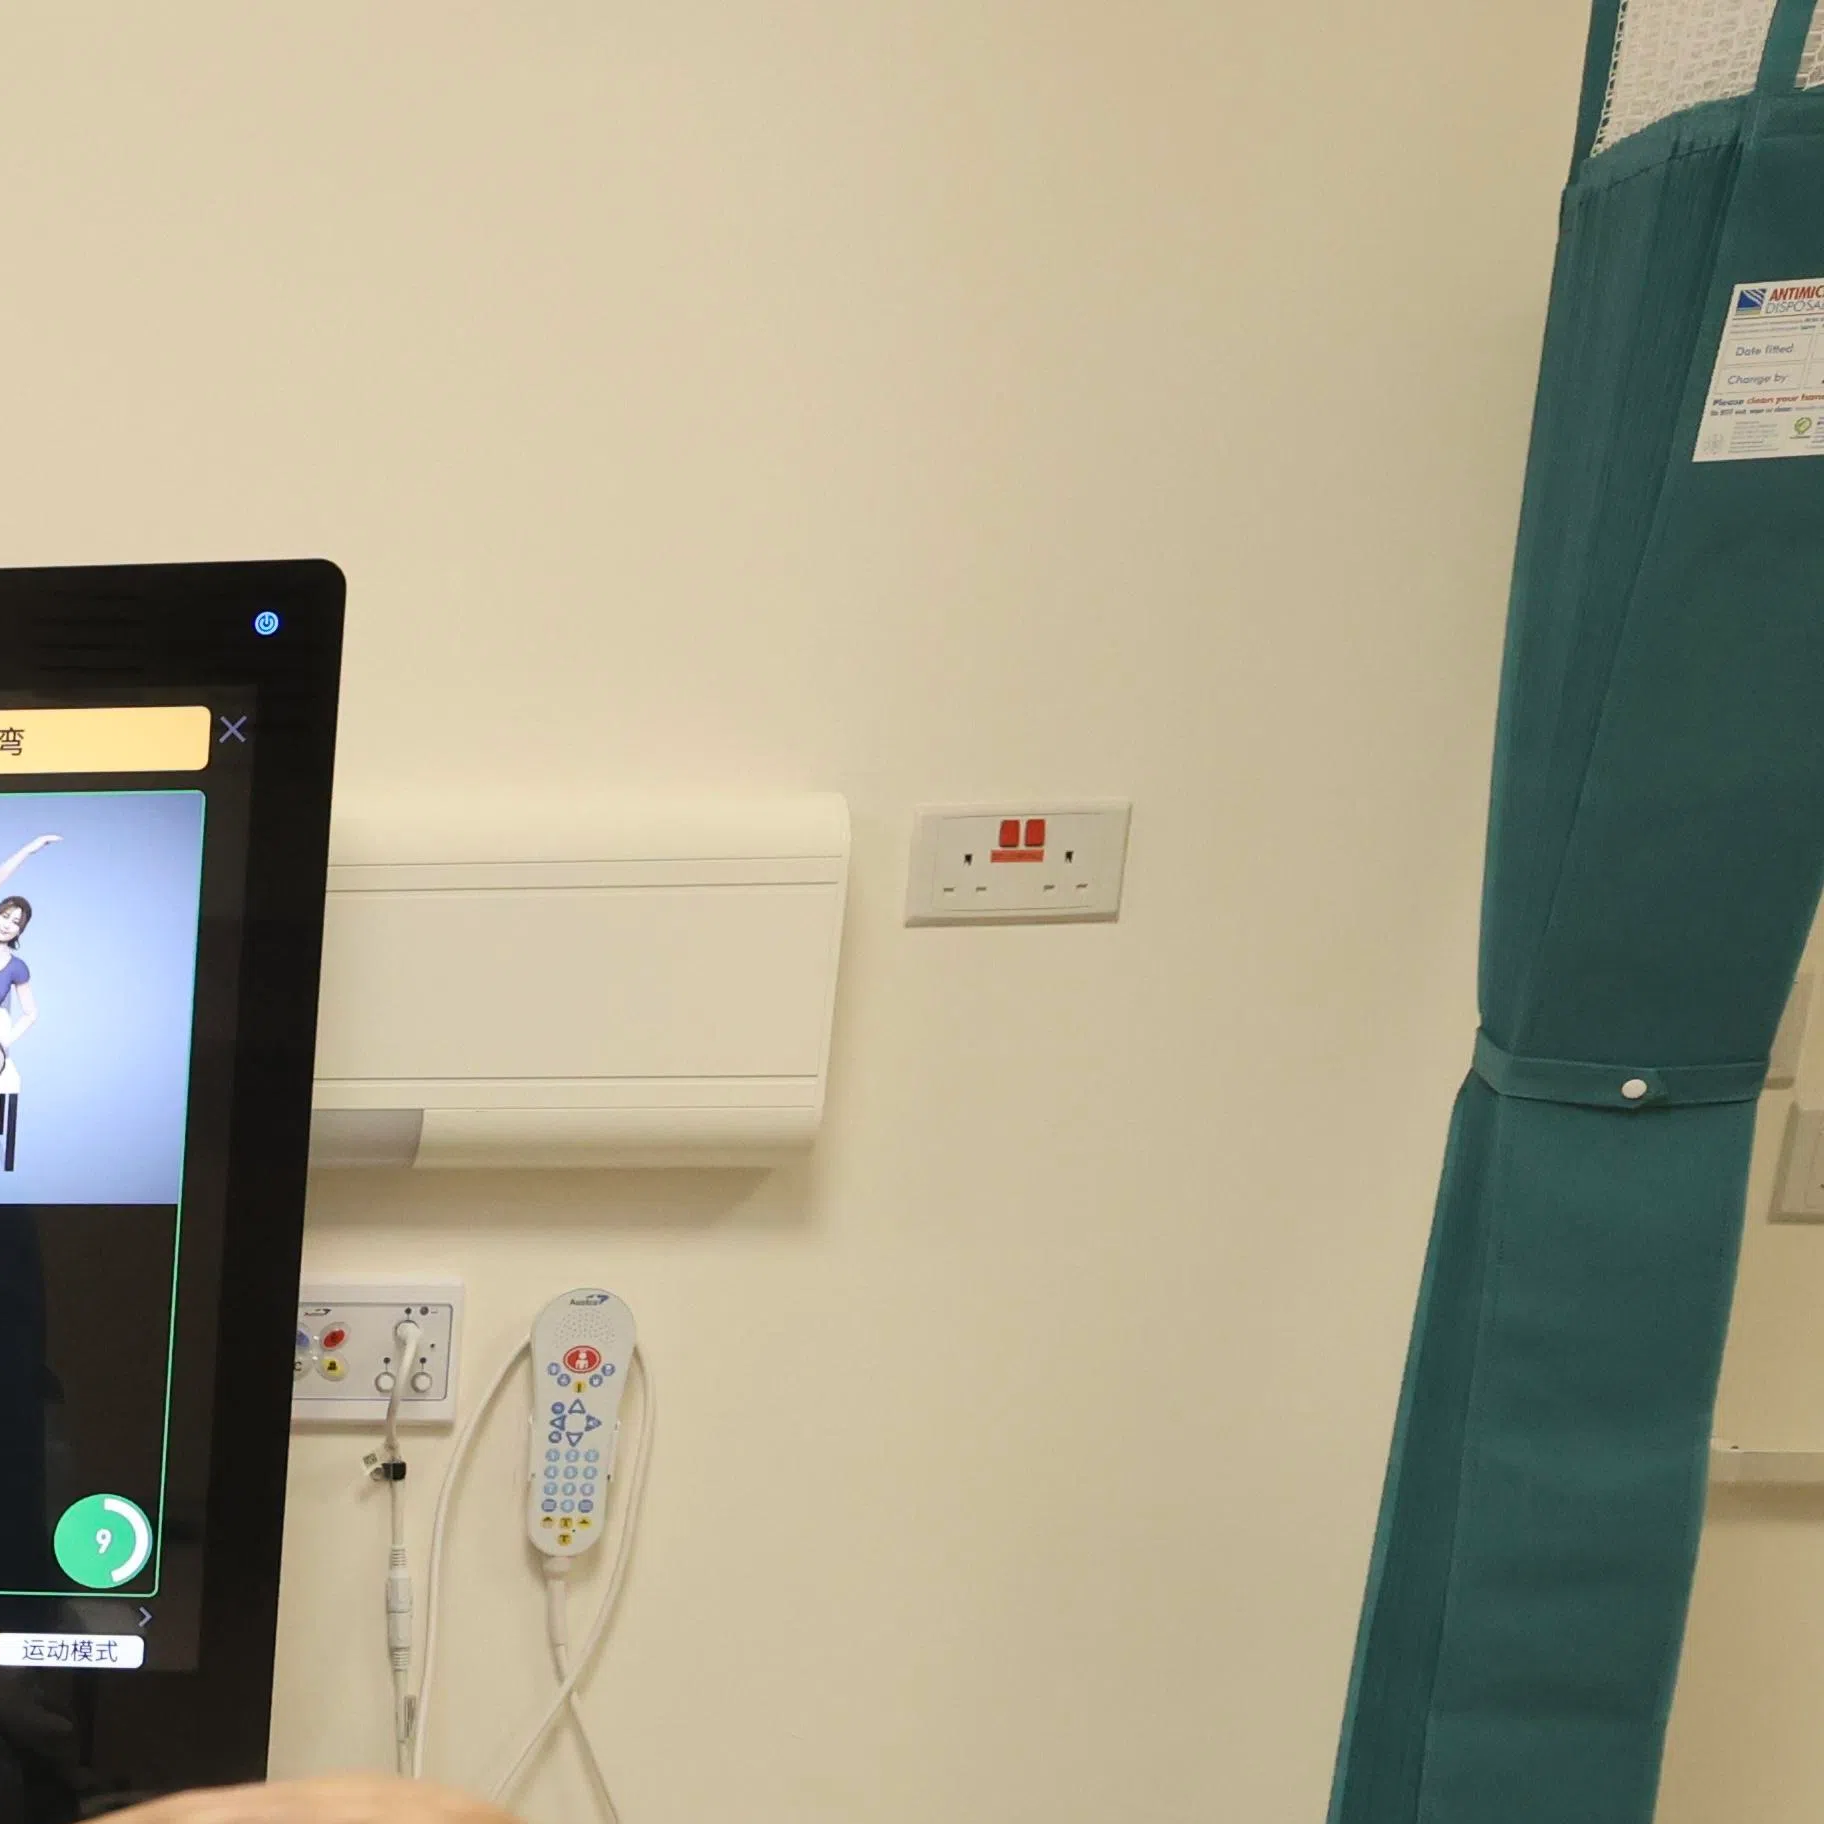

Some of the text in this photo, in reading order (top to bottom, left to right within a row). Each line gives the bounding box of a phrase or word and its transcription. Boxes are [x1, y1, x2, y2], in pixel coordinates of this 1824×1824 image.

[1736, 344, 1794, 357] Date fitted
[1728, 373, 1788, 386] Change by
[95, 1529, 113, 1555] 9
[22, 1639, 119, 1663] 运动模式
